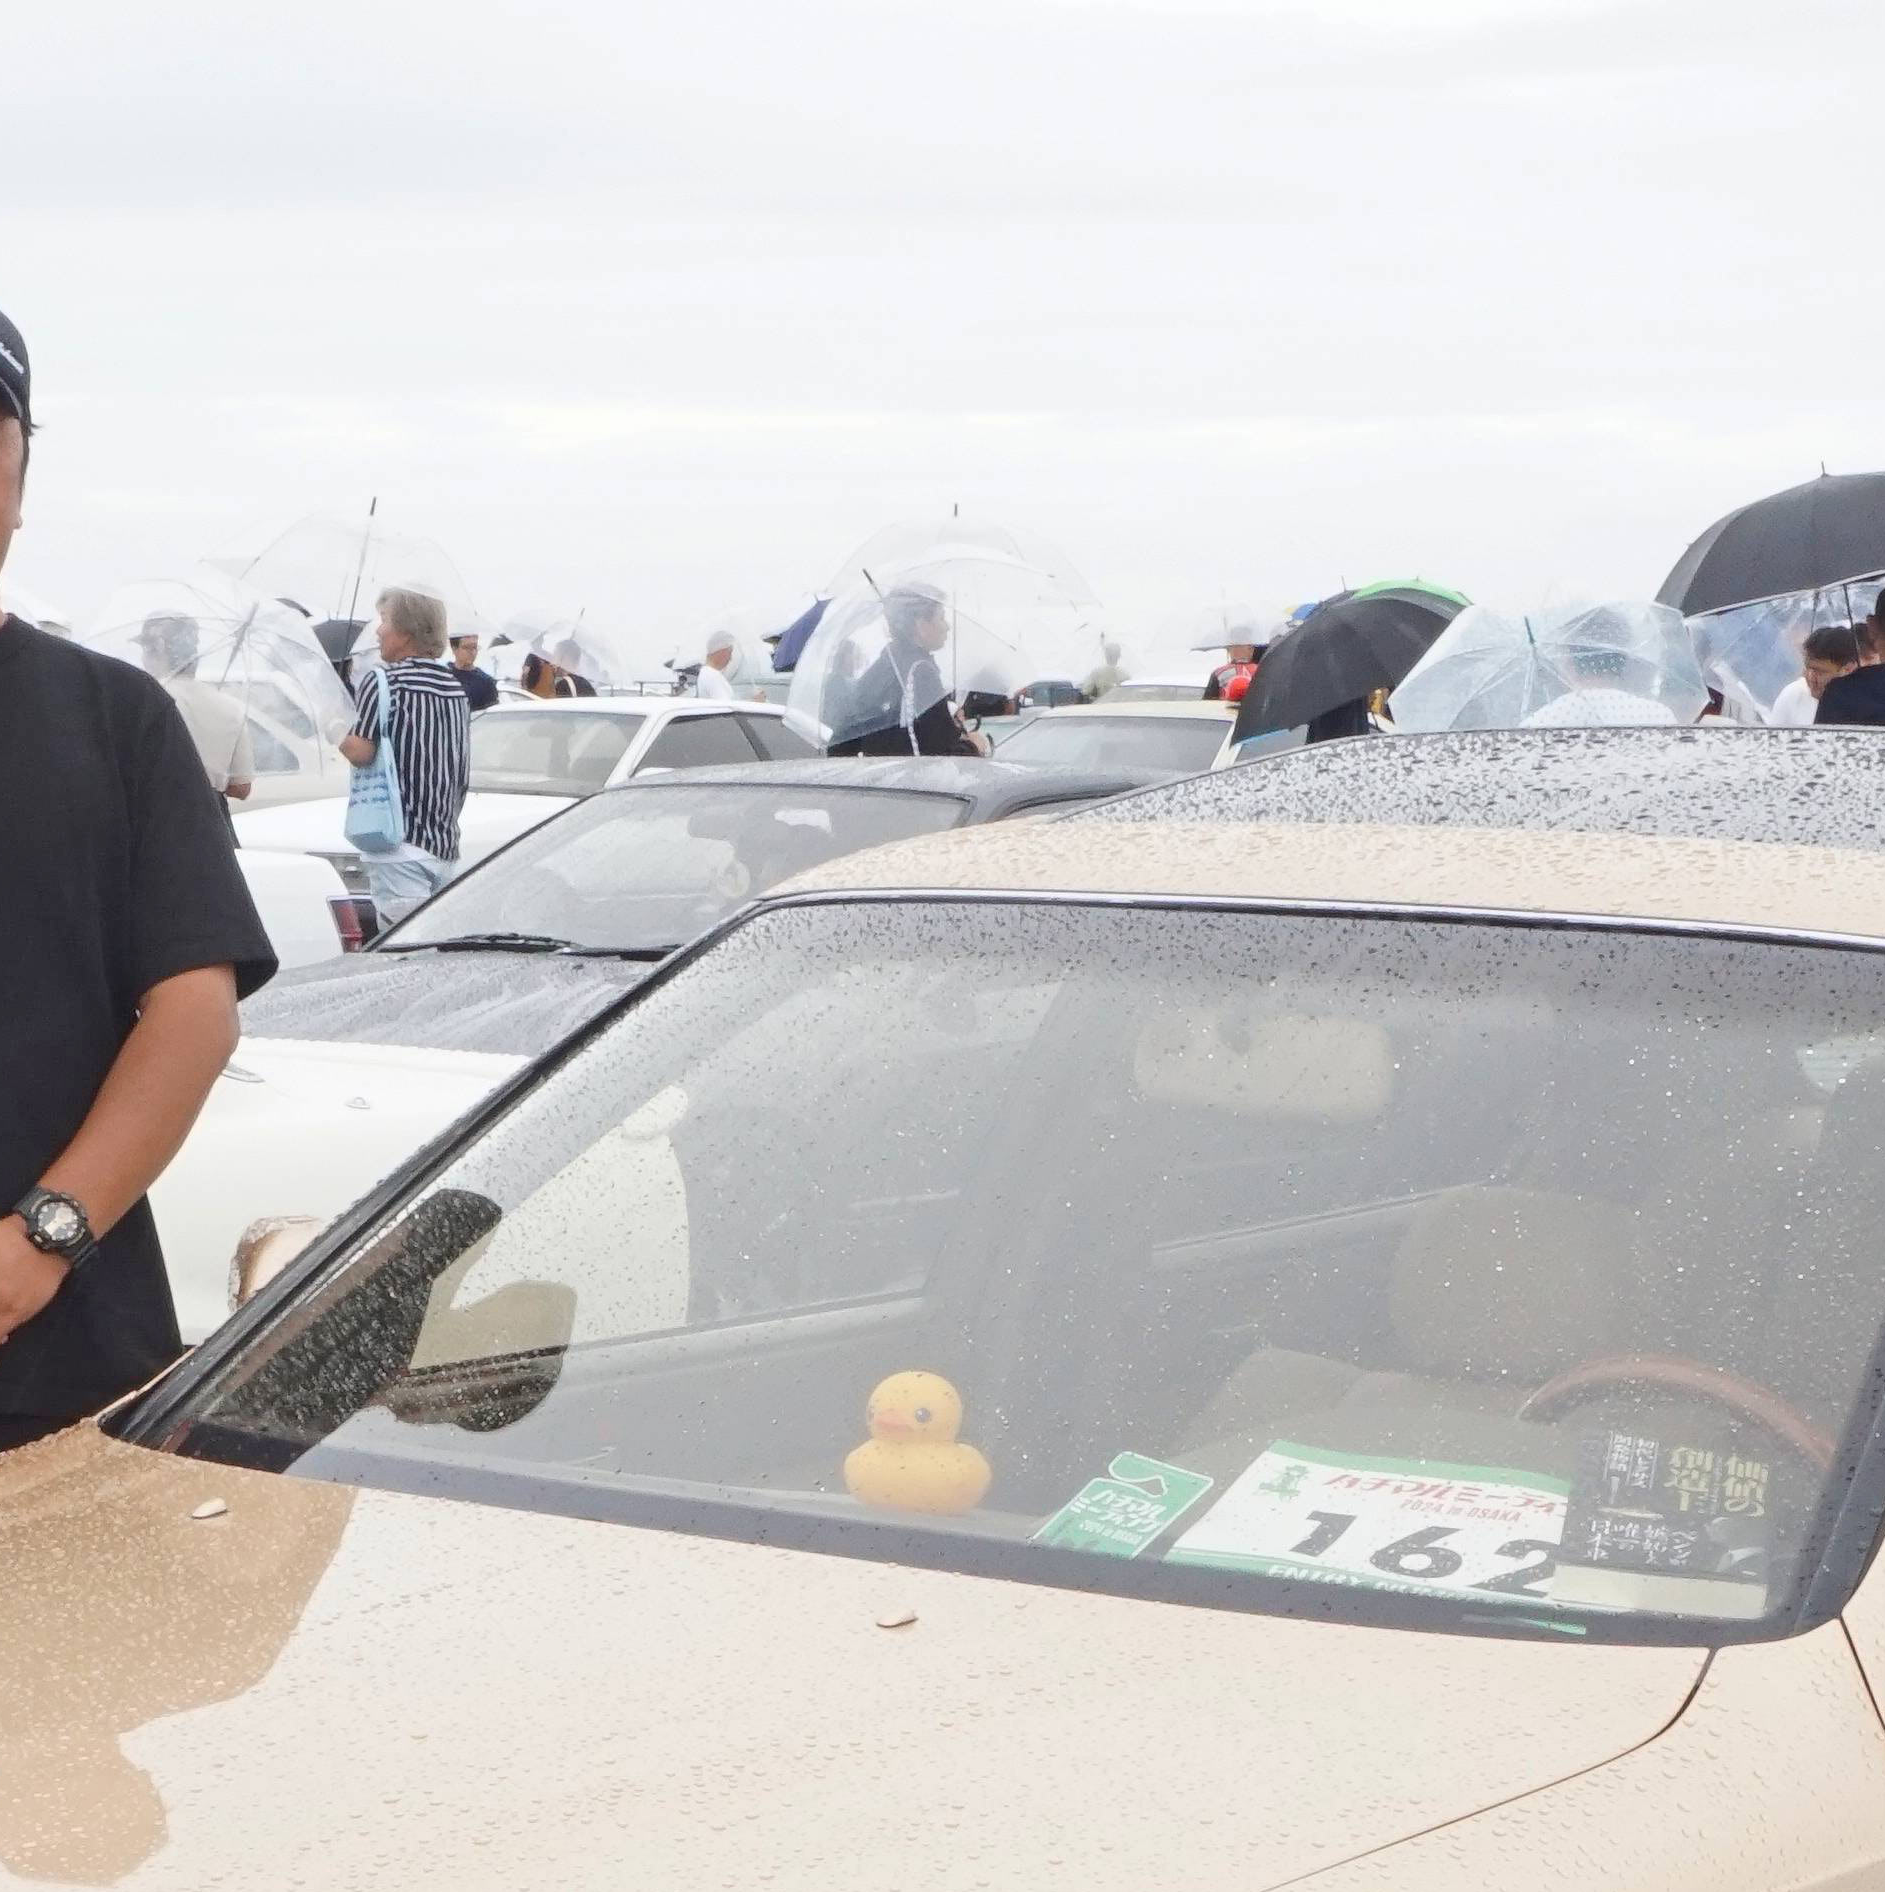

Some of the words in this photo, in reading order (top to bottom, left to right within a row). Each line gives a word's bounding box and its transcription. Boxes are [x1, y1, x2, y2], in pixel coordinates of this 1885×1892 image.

[1322, 1472, 1568, 1517] ハチマルミーティ
[1289, 1509, 1560, 1598] 162
